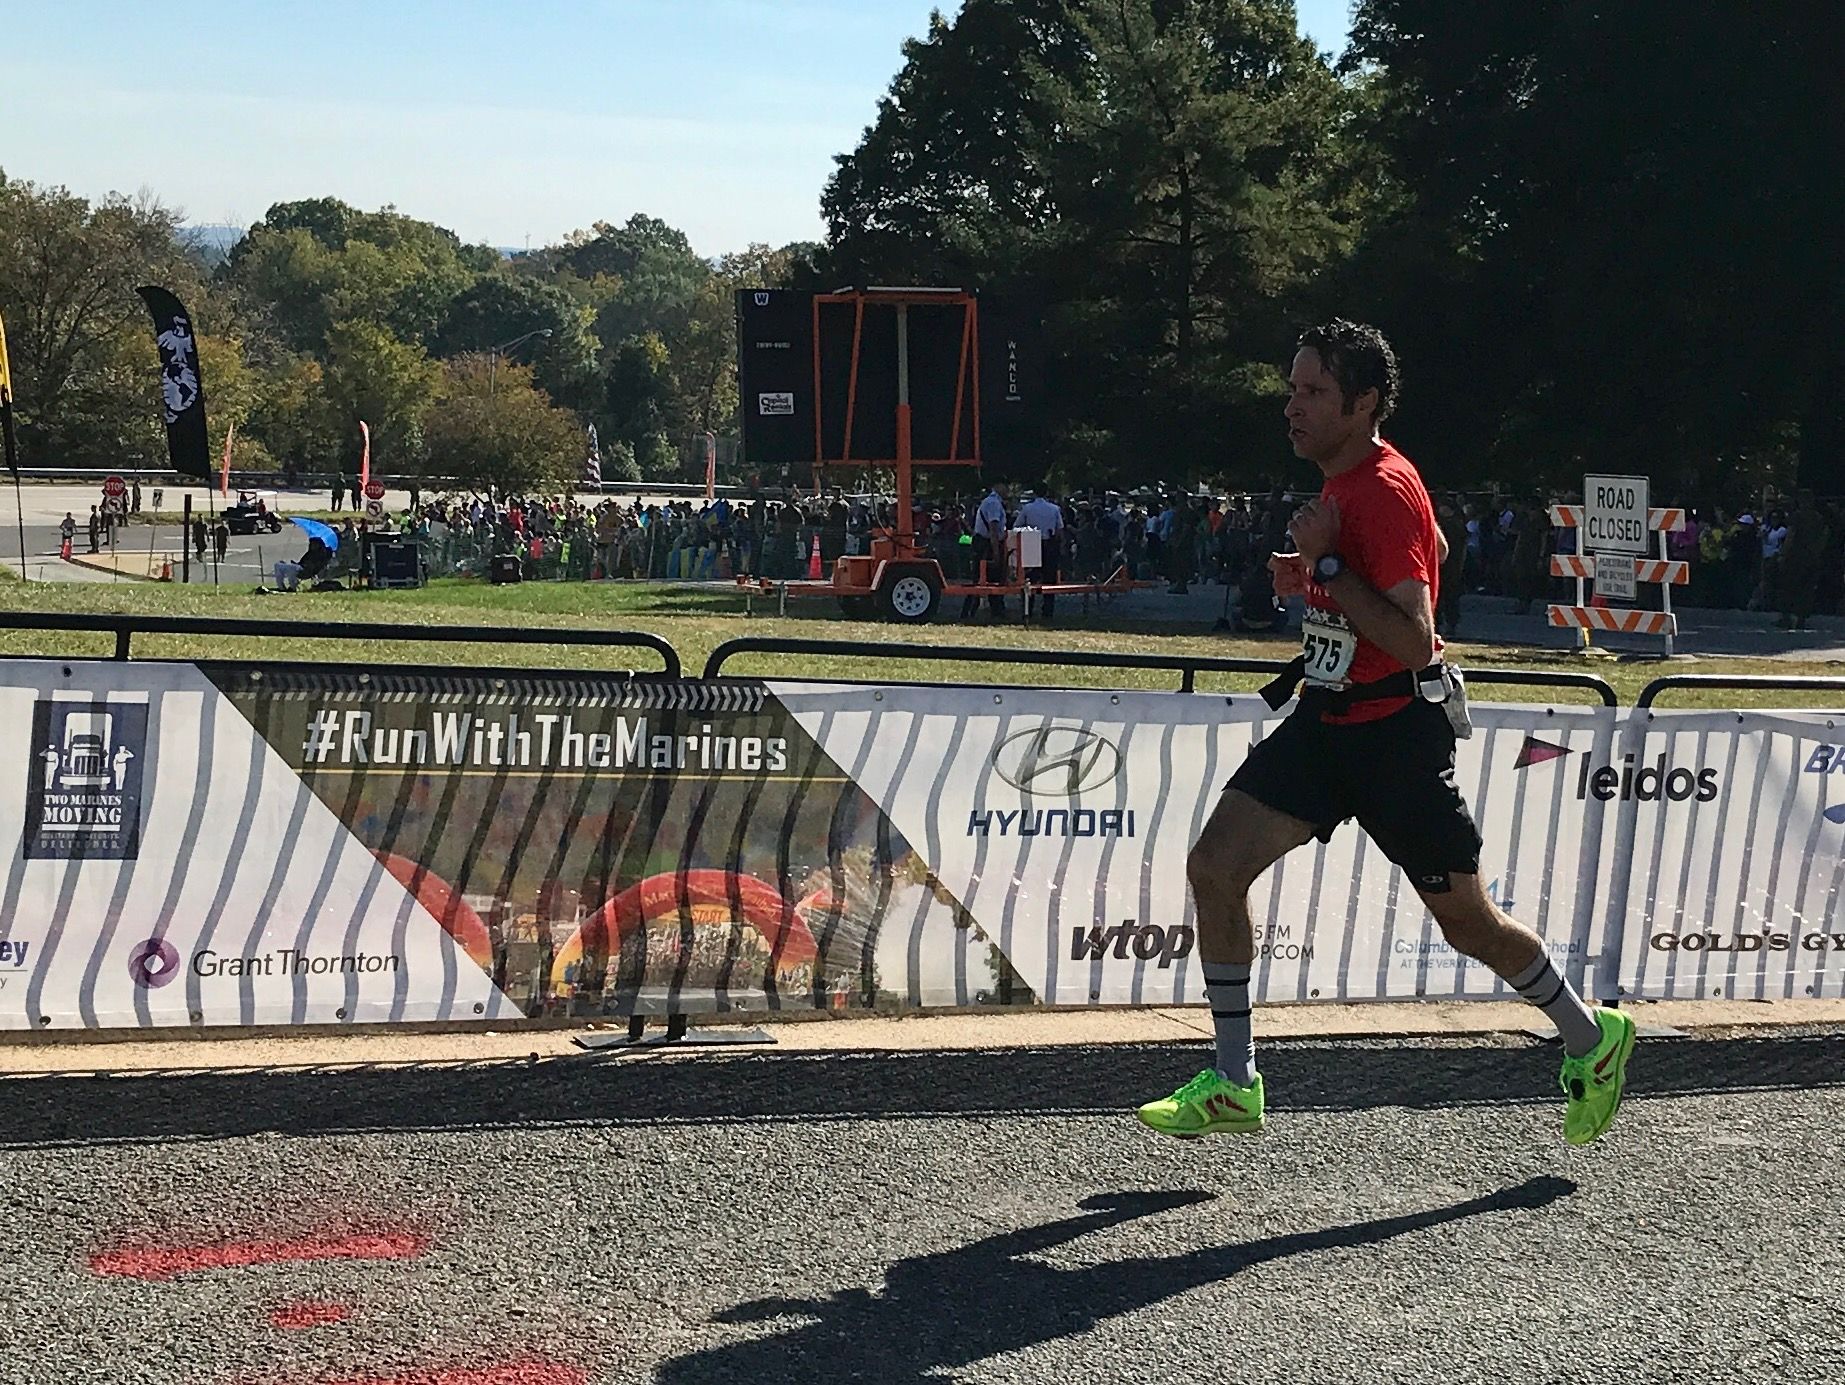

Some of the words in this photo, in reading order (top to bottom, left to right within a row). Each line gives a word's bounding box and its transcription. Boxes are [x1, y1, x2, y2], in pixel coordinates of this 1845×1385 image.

[106, 482, 124, 491] STOP
[366, 485, 384, 495] STOP
[1597, 487, 1634, 510] ROAD
[1589, 516, 1641, 542] CLOSED
[302, 710, 787, 771] #RunWithTheMarines
[1577, 751, 1718, 802] leidos
[44, 795, 68, 805] TWO
[70, 795, 122, 806] MARINES
[44, 807, 122, 823] MOVING
[967, 810, 1135, 837] HYUNDAI
[1071, 919, 1194, 968] wtop
[1267, 925, 1290, 940] FM
[1650, 929, 1791, 951] GOLD'S
[1395, 939, 1455, 954] Columb
[193, 950, 273, 976] Grant
[276, 950, 399, 975] Thornton
[1400, 959, 1412, 969] AT
[1436, 959, 1466, 969] VERY
